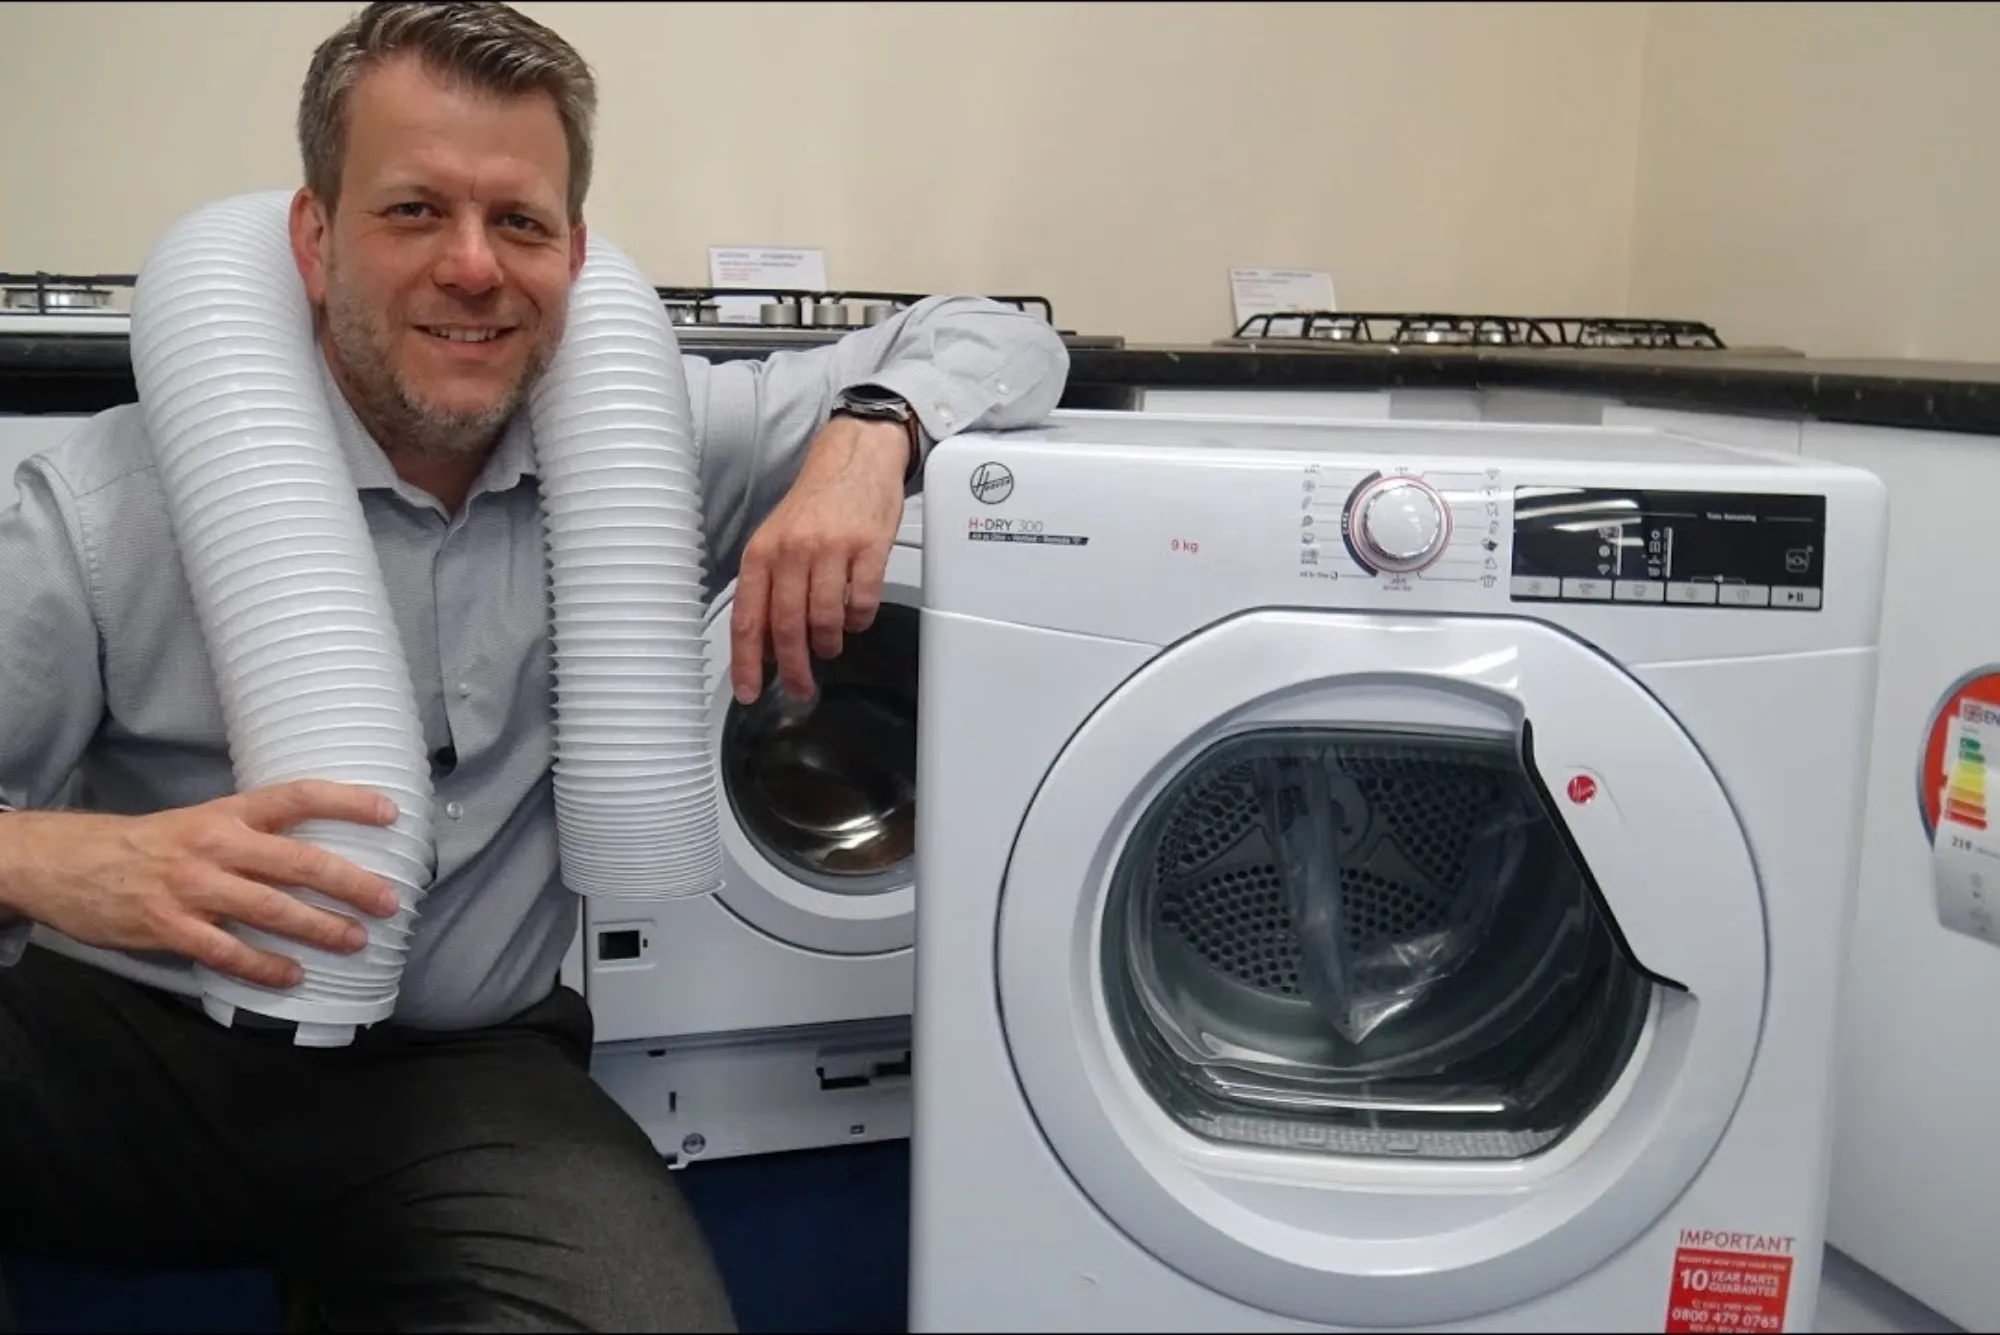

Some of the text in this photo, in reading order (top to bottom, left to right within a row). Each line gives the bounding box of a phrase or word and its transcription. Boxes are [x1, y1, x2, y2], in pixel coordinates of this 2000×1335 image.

[968, 517, 1043, 533] H-DRY 300
[1171, 539, 1199, 553] 9 kg
[1680, 1229, 1796, 1253] IMPORTANT
[1681, 1268, 1709, 1291] 10
[1711, 1271, 1741, 1282] YEAR
[1708, 1281, 1778, 1297] GUARANTEE
[1672, 1307, 1708, 1322] 0800
